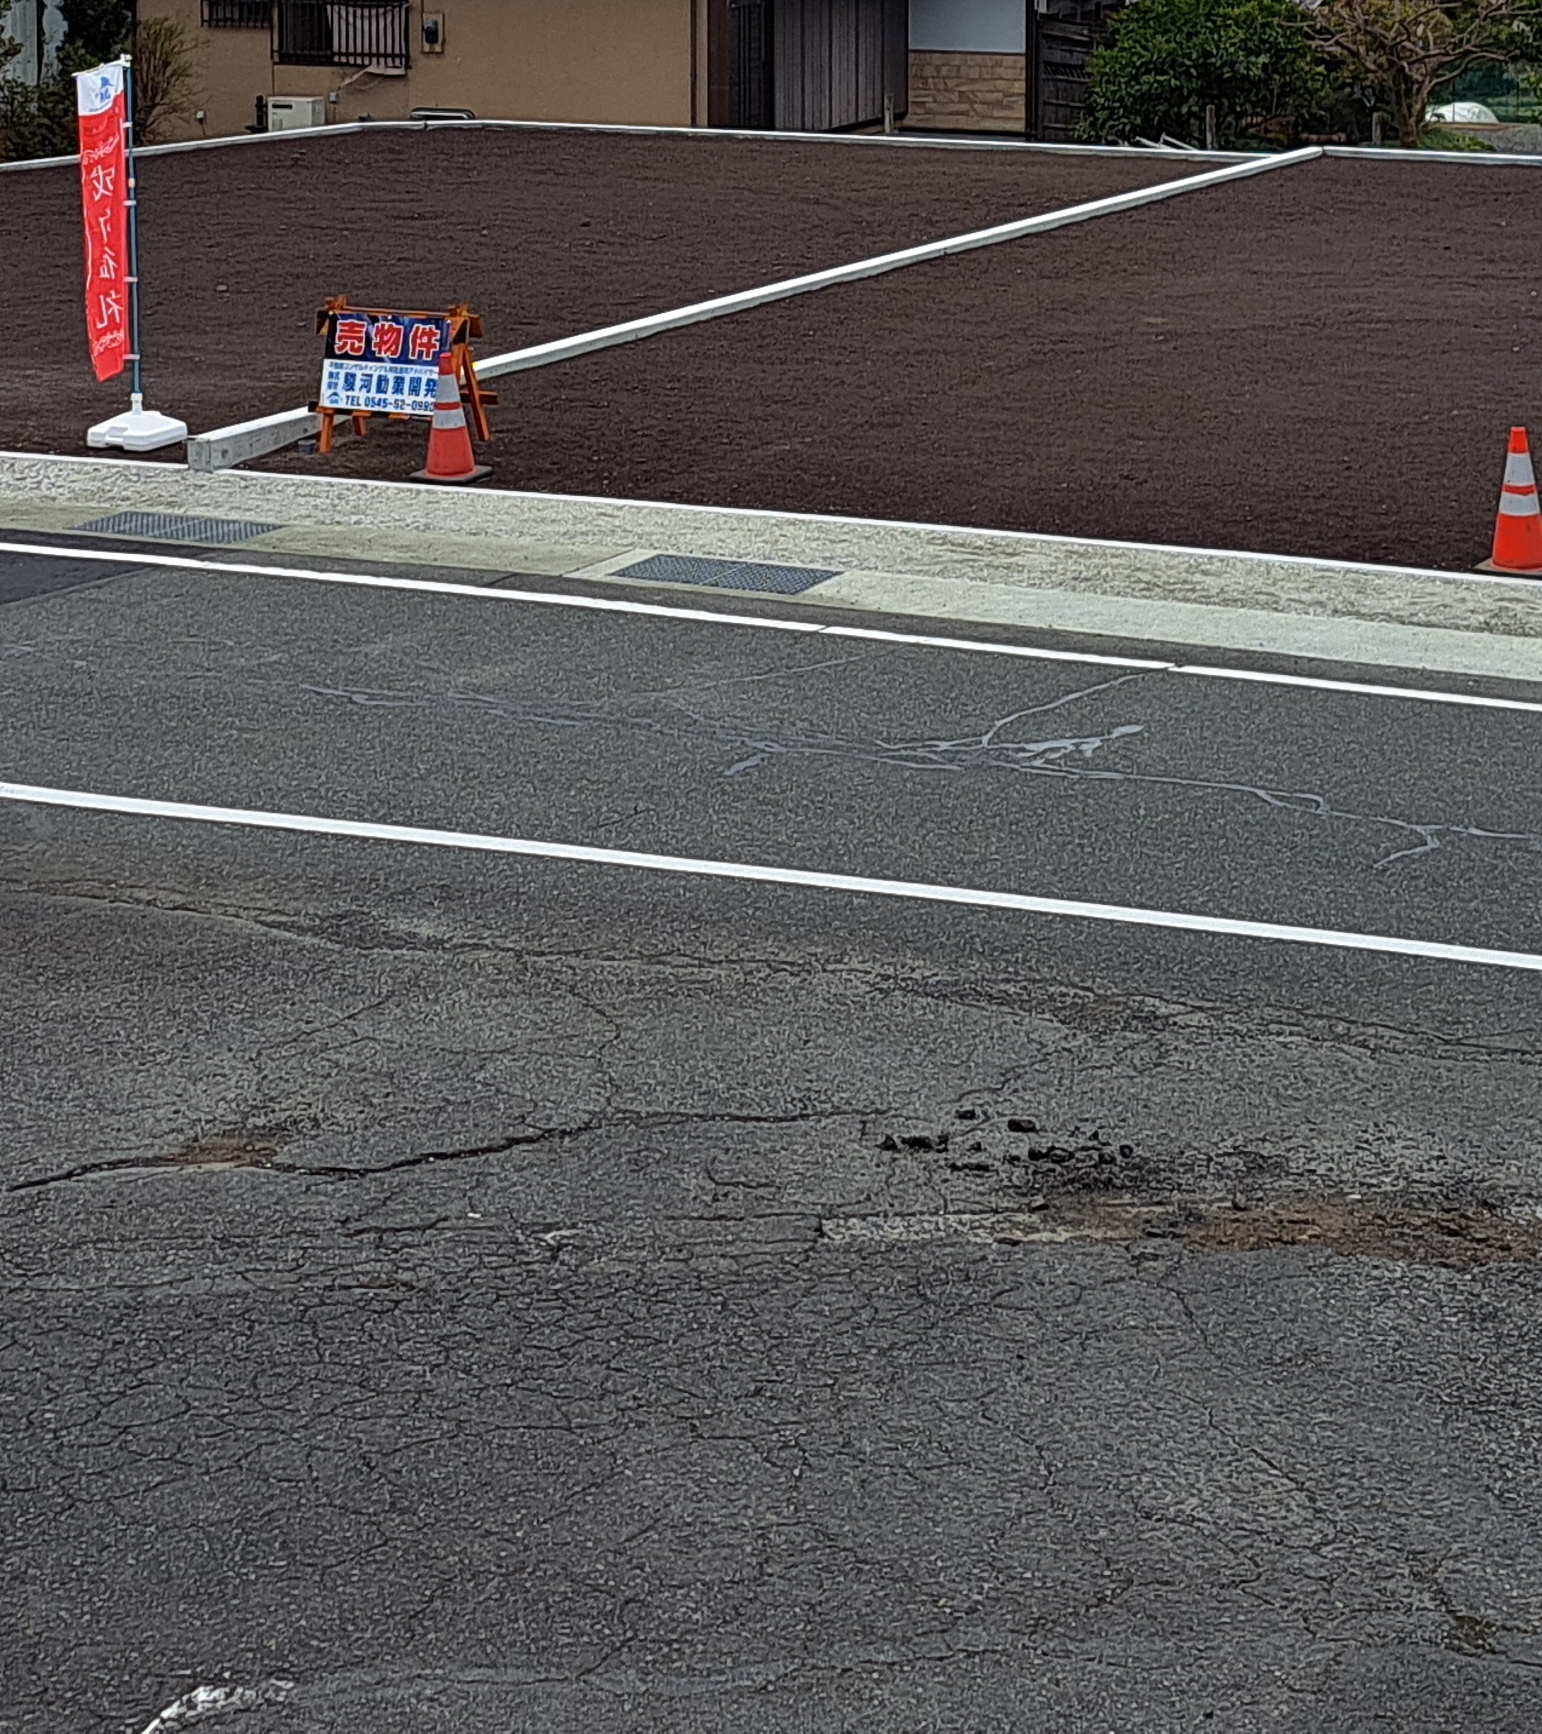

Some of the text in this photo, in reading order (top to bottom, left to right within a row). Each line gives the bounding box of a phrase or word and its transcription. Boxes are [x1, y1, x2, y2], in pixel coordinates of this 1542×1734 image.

[335, 320, 440, 359] 売物件
[345, 395, 361, 407] TEL
